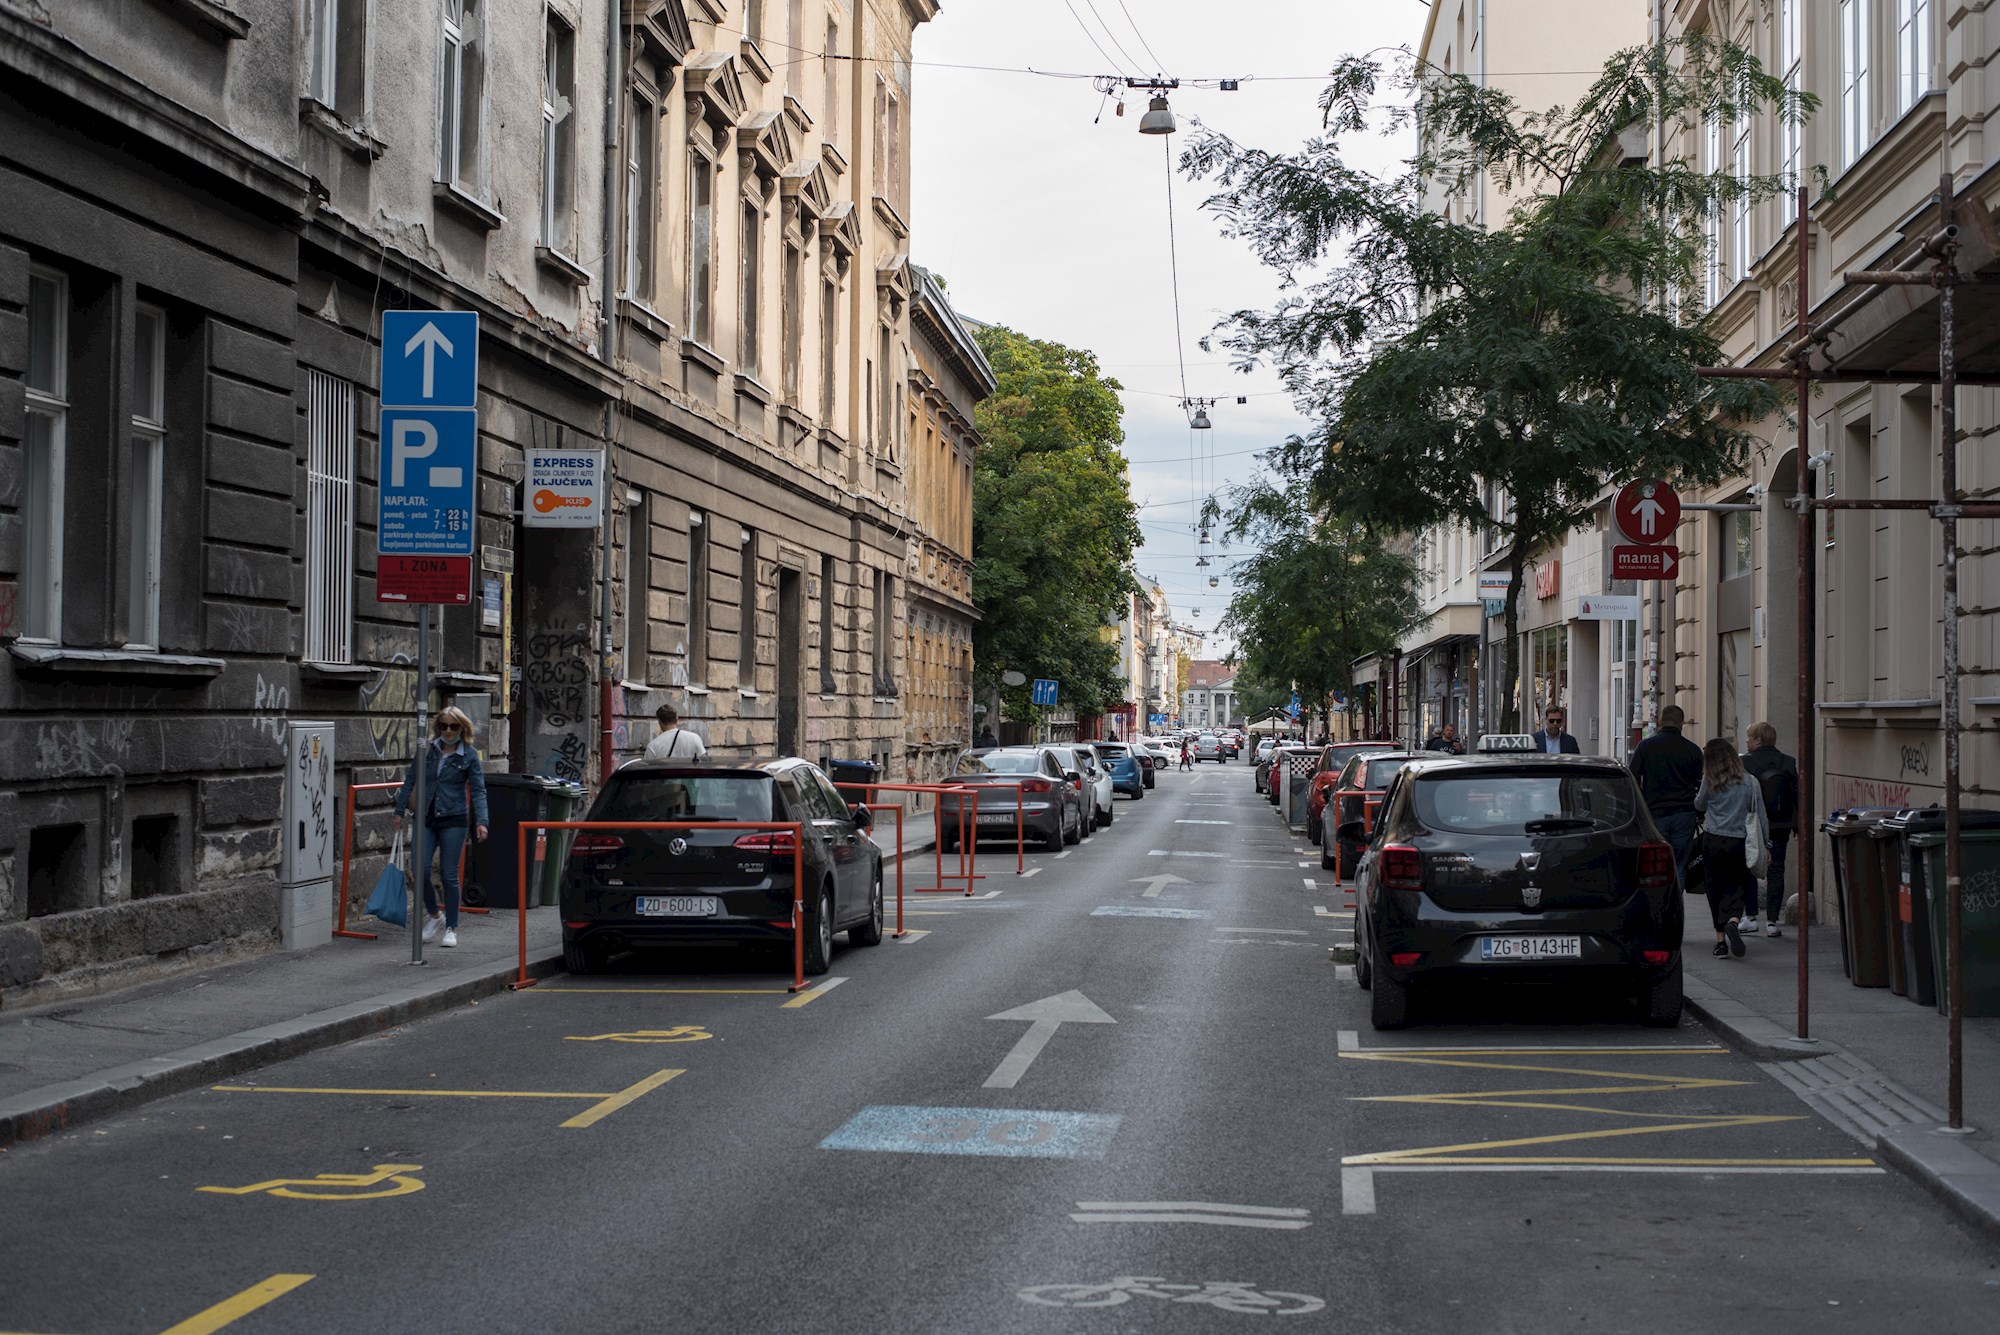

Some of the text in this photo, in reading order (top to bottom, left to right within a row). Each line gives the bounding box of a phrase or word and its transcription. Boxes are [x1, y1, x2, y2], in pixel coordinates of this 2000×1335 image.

[391, 418, 439, 488] P
[533, 458, 594, 468] EXPRESS
[533, 478, 593, 486] KLJUČEVA
[384, 496, 429, 506] NAPLATA:
[411, 511, 428, 519] petak
[434, 509, 440, 519] 7
[447, 509, 460, 520] 22
[462, 509, 469, 519] h
[384, 522, 405, 530] subota
[434, 520, 440, 530] 7
[447, 520, 460, 531] 15
[462, 520, 469, 530] h
[384, 532, 414, 540] parkiranje
[414, 532, 446, 540] dozvoljeno
[384, 541, 414, 549] kupljenom
[414, 541, 446, 549] parkirnom
[1618, 554, 1660, 564] mama
[412, 560, 448, 572] ZONA
[1487, 737, 1528, 748] TAXI
[646, 899, 660, 912] ZD
[1493, 939, 1510, 955] ZG
[908, 1117, 1057, 1146] 30
